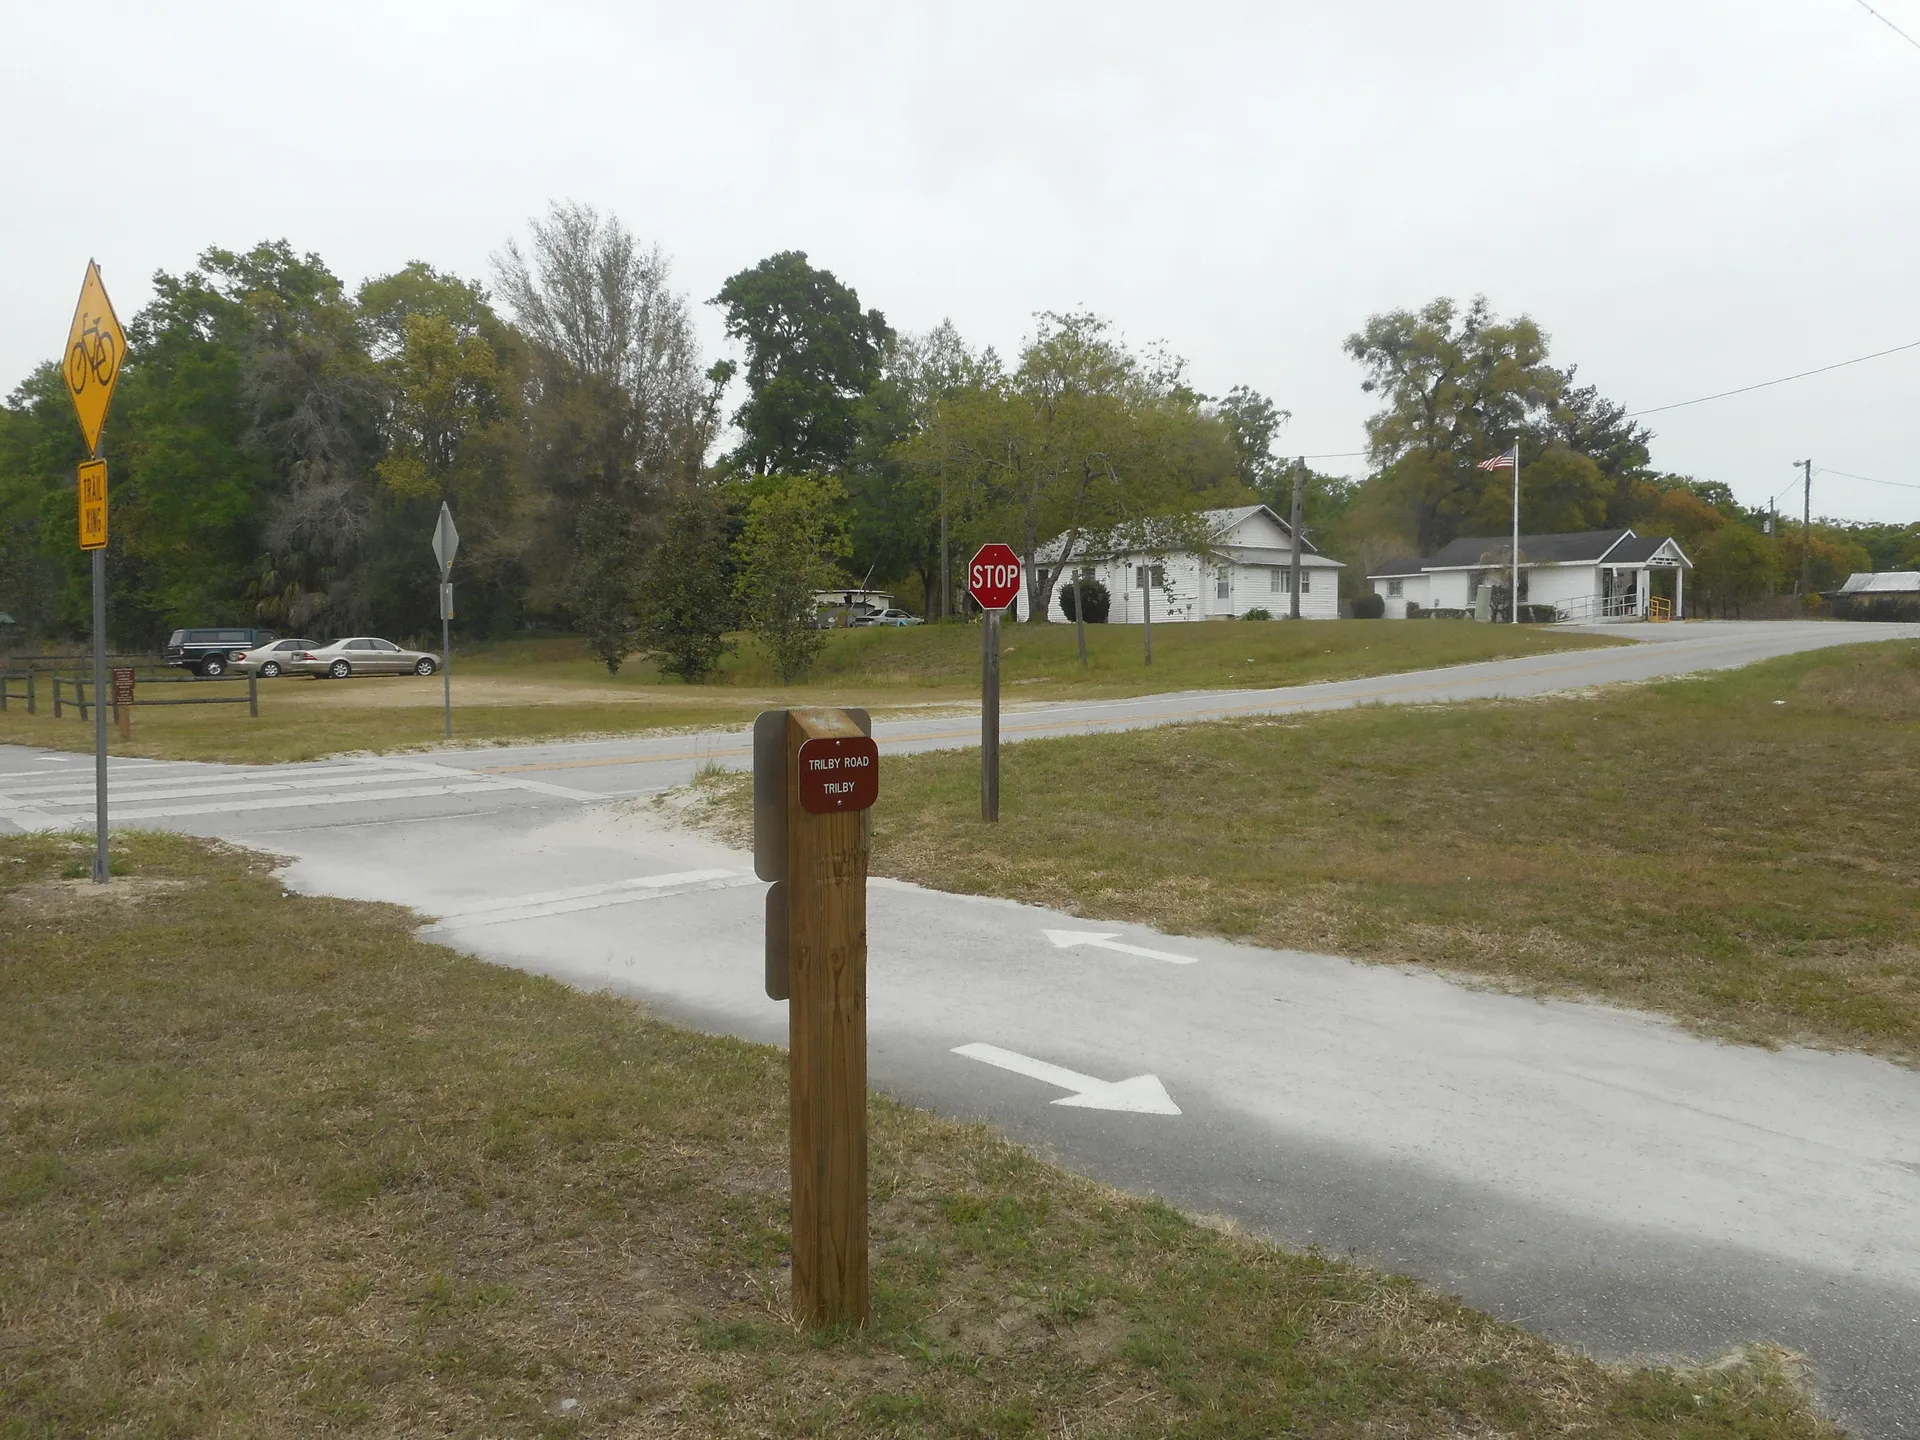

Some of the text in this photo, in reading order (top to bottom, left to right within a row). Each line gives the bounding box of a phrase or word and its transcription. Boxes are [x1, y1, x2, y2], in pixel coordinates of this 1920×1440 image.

[972, 564, 1019, 589] STOP
[809, 756, 869, 770] TRILBY ROAD
[824, 782, 855, 794] TRILBY
